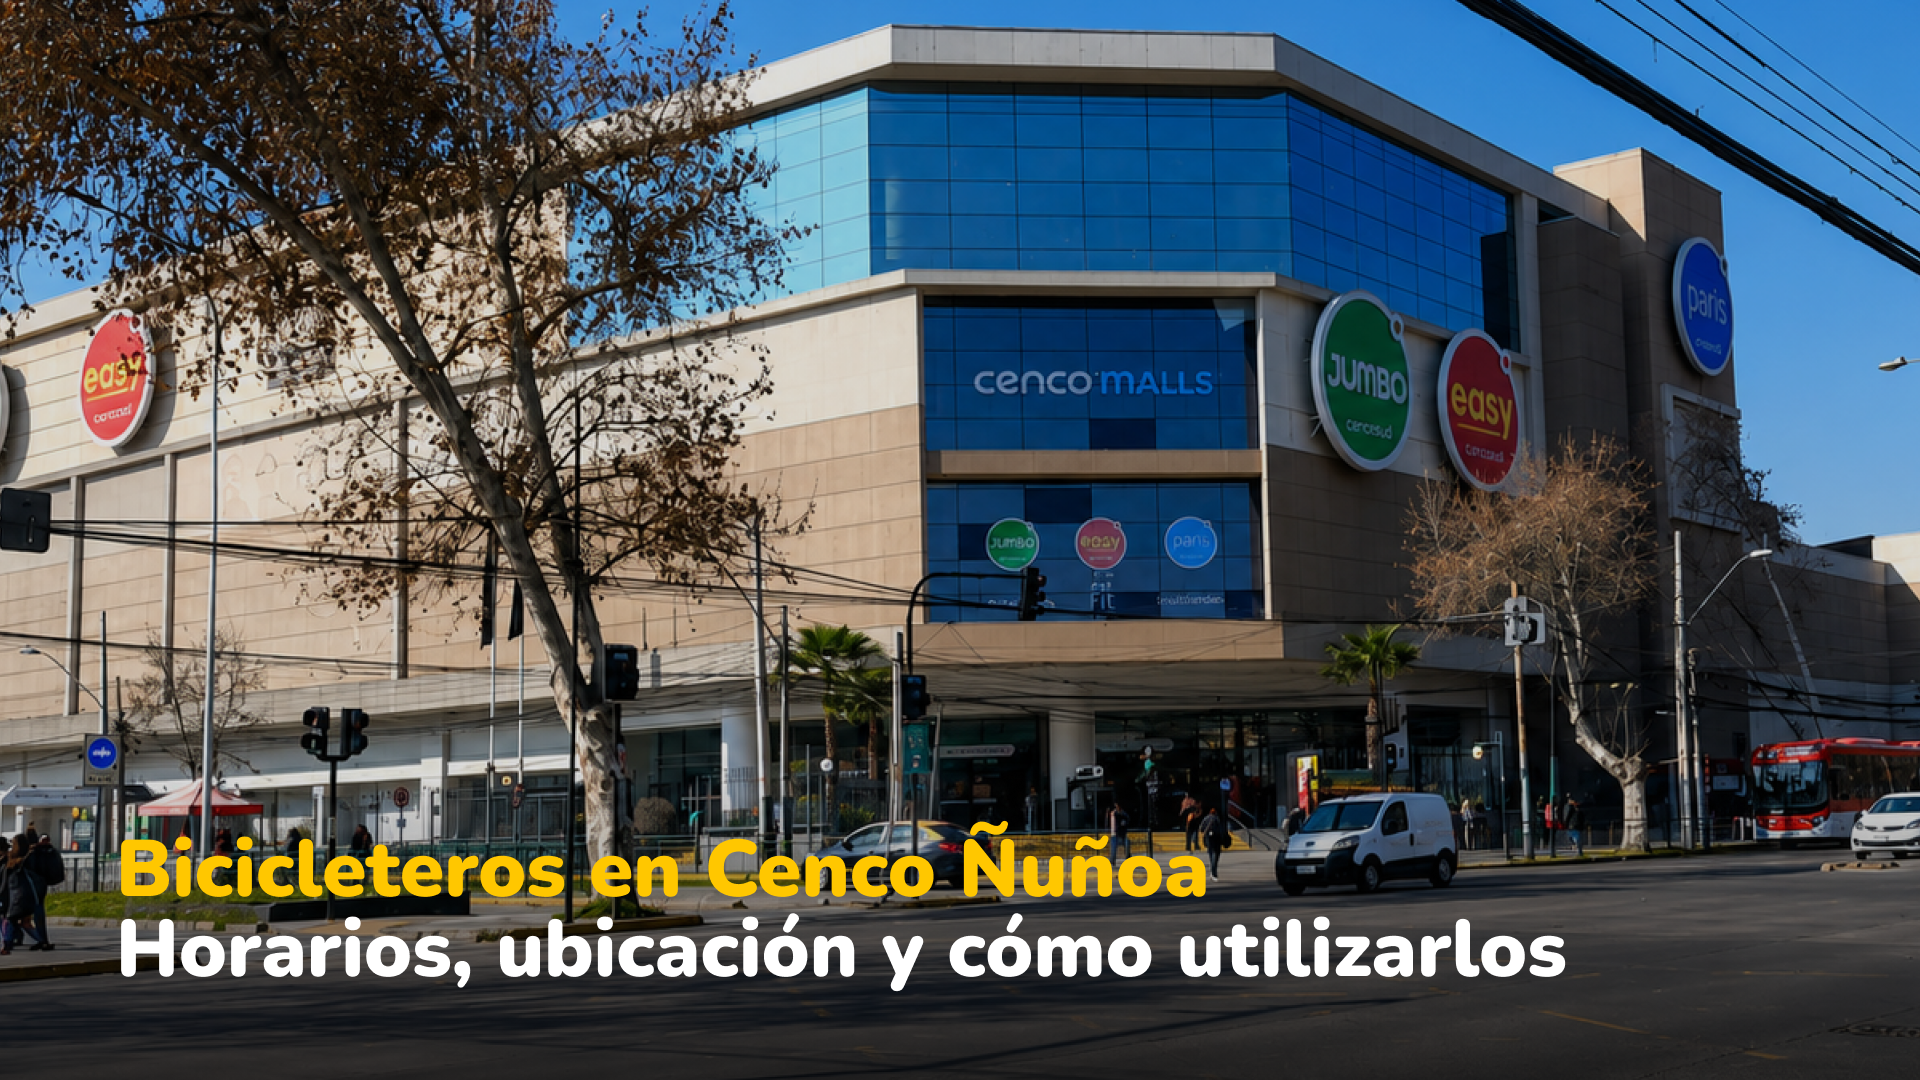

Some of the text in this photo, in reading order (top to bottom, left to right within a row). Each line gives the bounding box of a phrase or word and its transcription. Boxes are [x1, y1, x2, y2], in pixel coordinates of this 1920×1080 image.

[1687, 283, 1728, 326] paris
[83, 355, 142, 395] easy
[974, 370, 1093, 395] cenco
[1327, 352, 1408, 404] JUMBO
[1451, 382, 1513, 441] easy
[989, 536, 1035, 549] JUMBO
[1080, 535, 1121, 550] easy
[1173, 534, 1210, 549] paris
